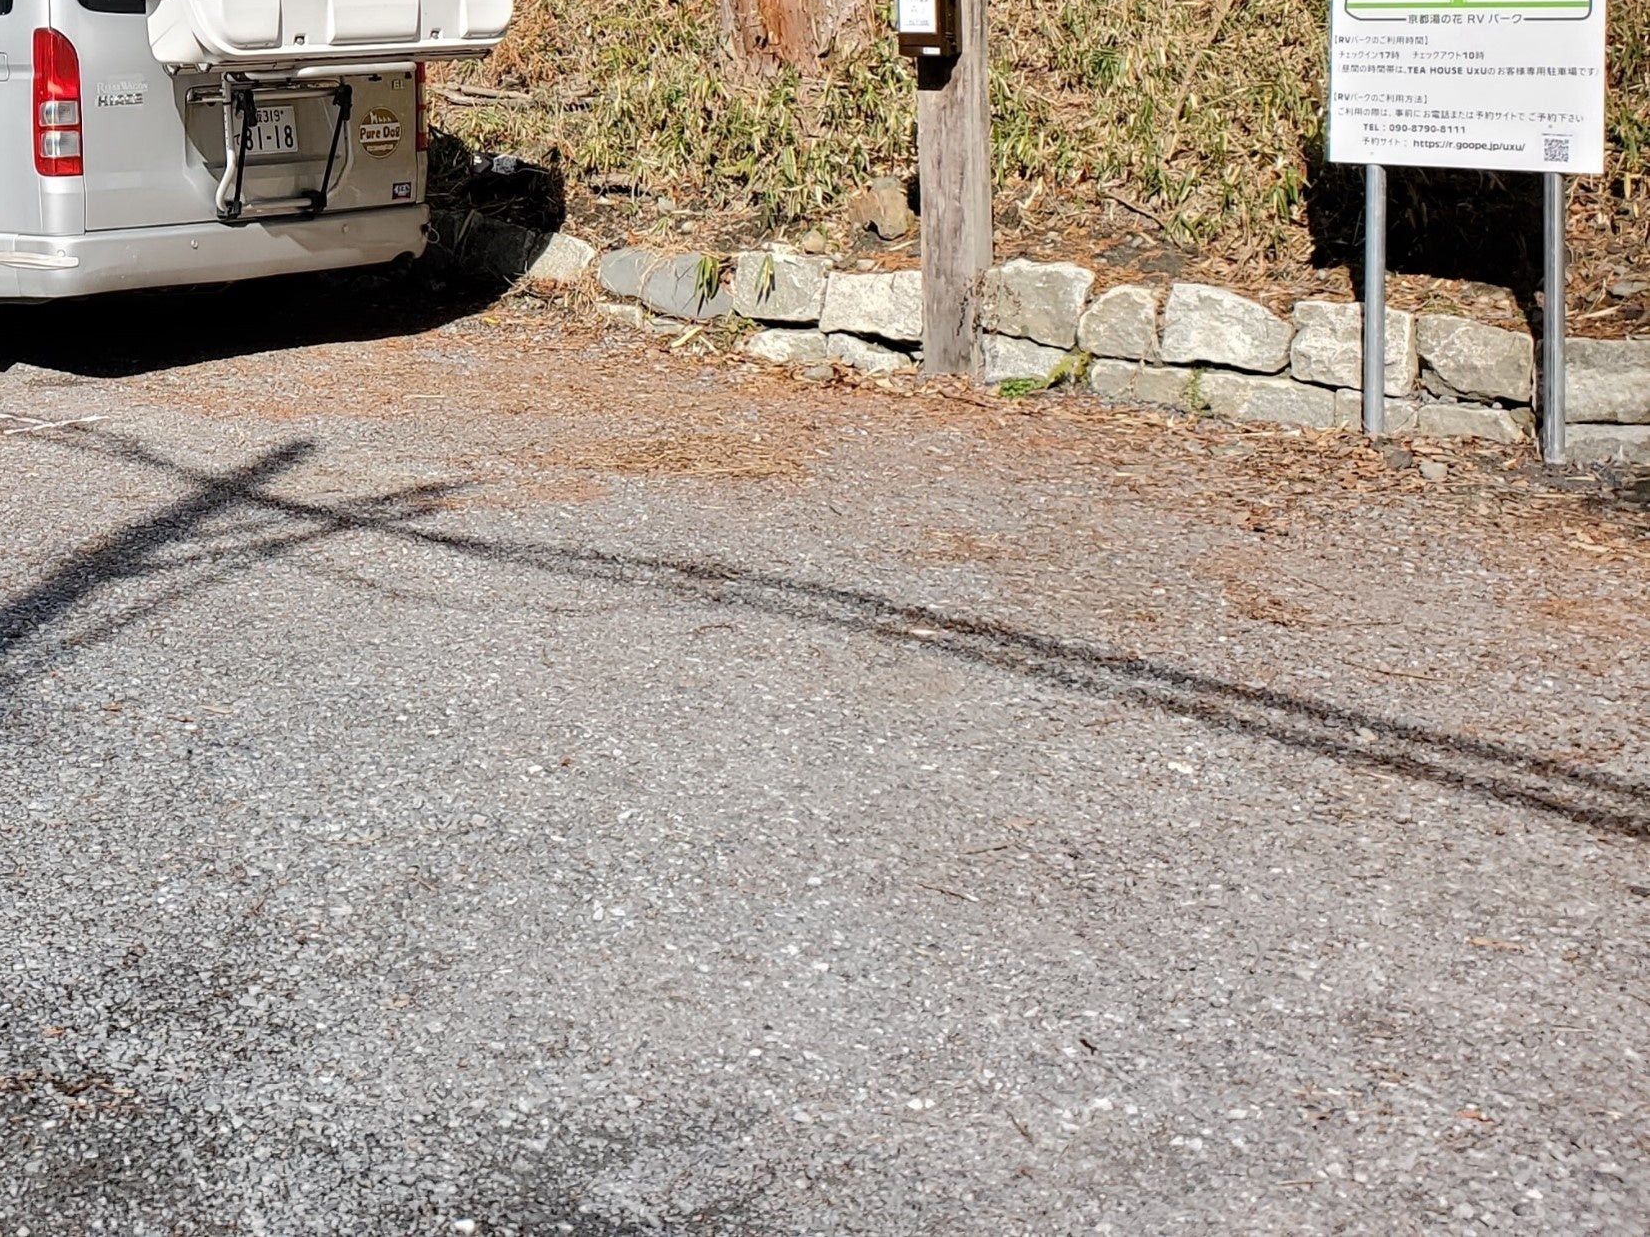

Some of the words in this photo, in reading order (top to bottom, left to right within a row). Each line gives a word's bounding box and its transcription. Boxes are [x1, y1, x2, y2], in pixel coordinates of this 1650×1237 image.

[1407, 13, 1463, 24] 京都湯の花
[1467, 14, 1486, 24] RV
[1488, 13, 1523, 24] パーク
[360, 127, 381, 140] Pure
[383, 126, 400, 138] Dog
[1389, 124, 1466, 134] 090-8790-8111
